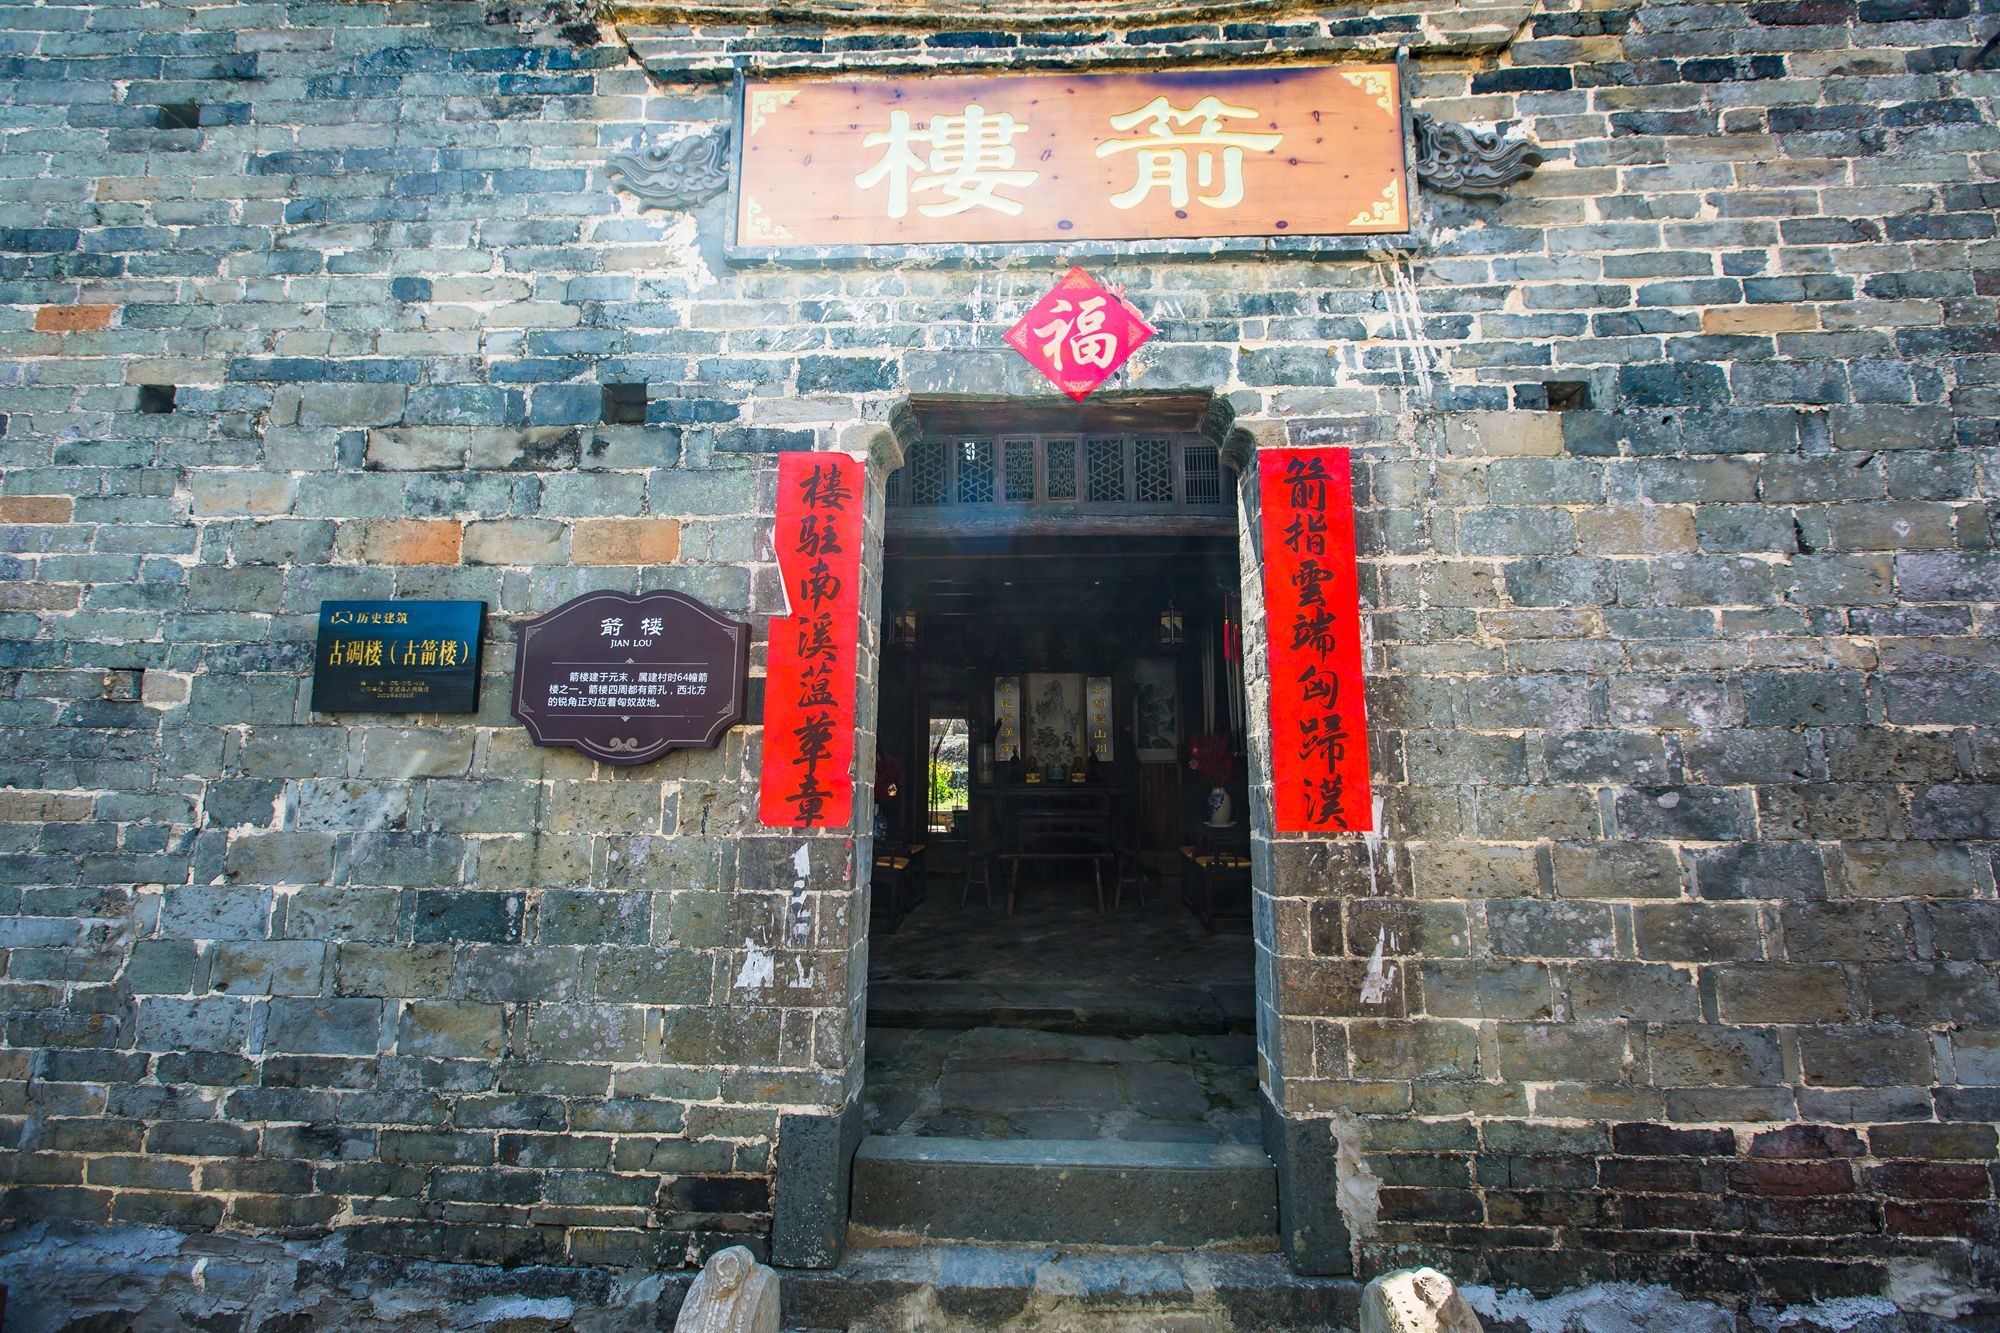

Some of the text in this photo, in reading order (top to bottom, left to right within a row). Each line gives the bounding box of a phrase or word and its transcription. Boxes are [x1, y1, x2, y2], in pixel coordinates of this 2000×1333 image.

[1032, 296, 1120, 372] 福
[356, 611, 408, 625] 历史建筑
[610, 639, 652, 648] JIAN LOU
